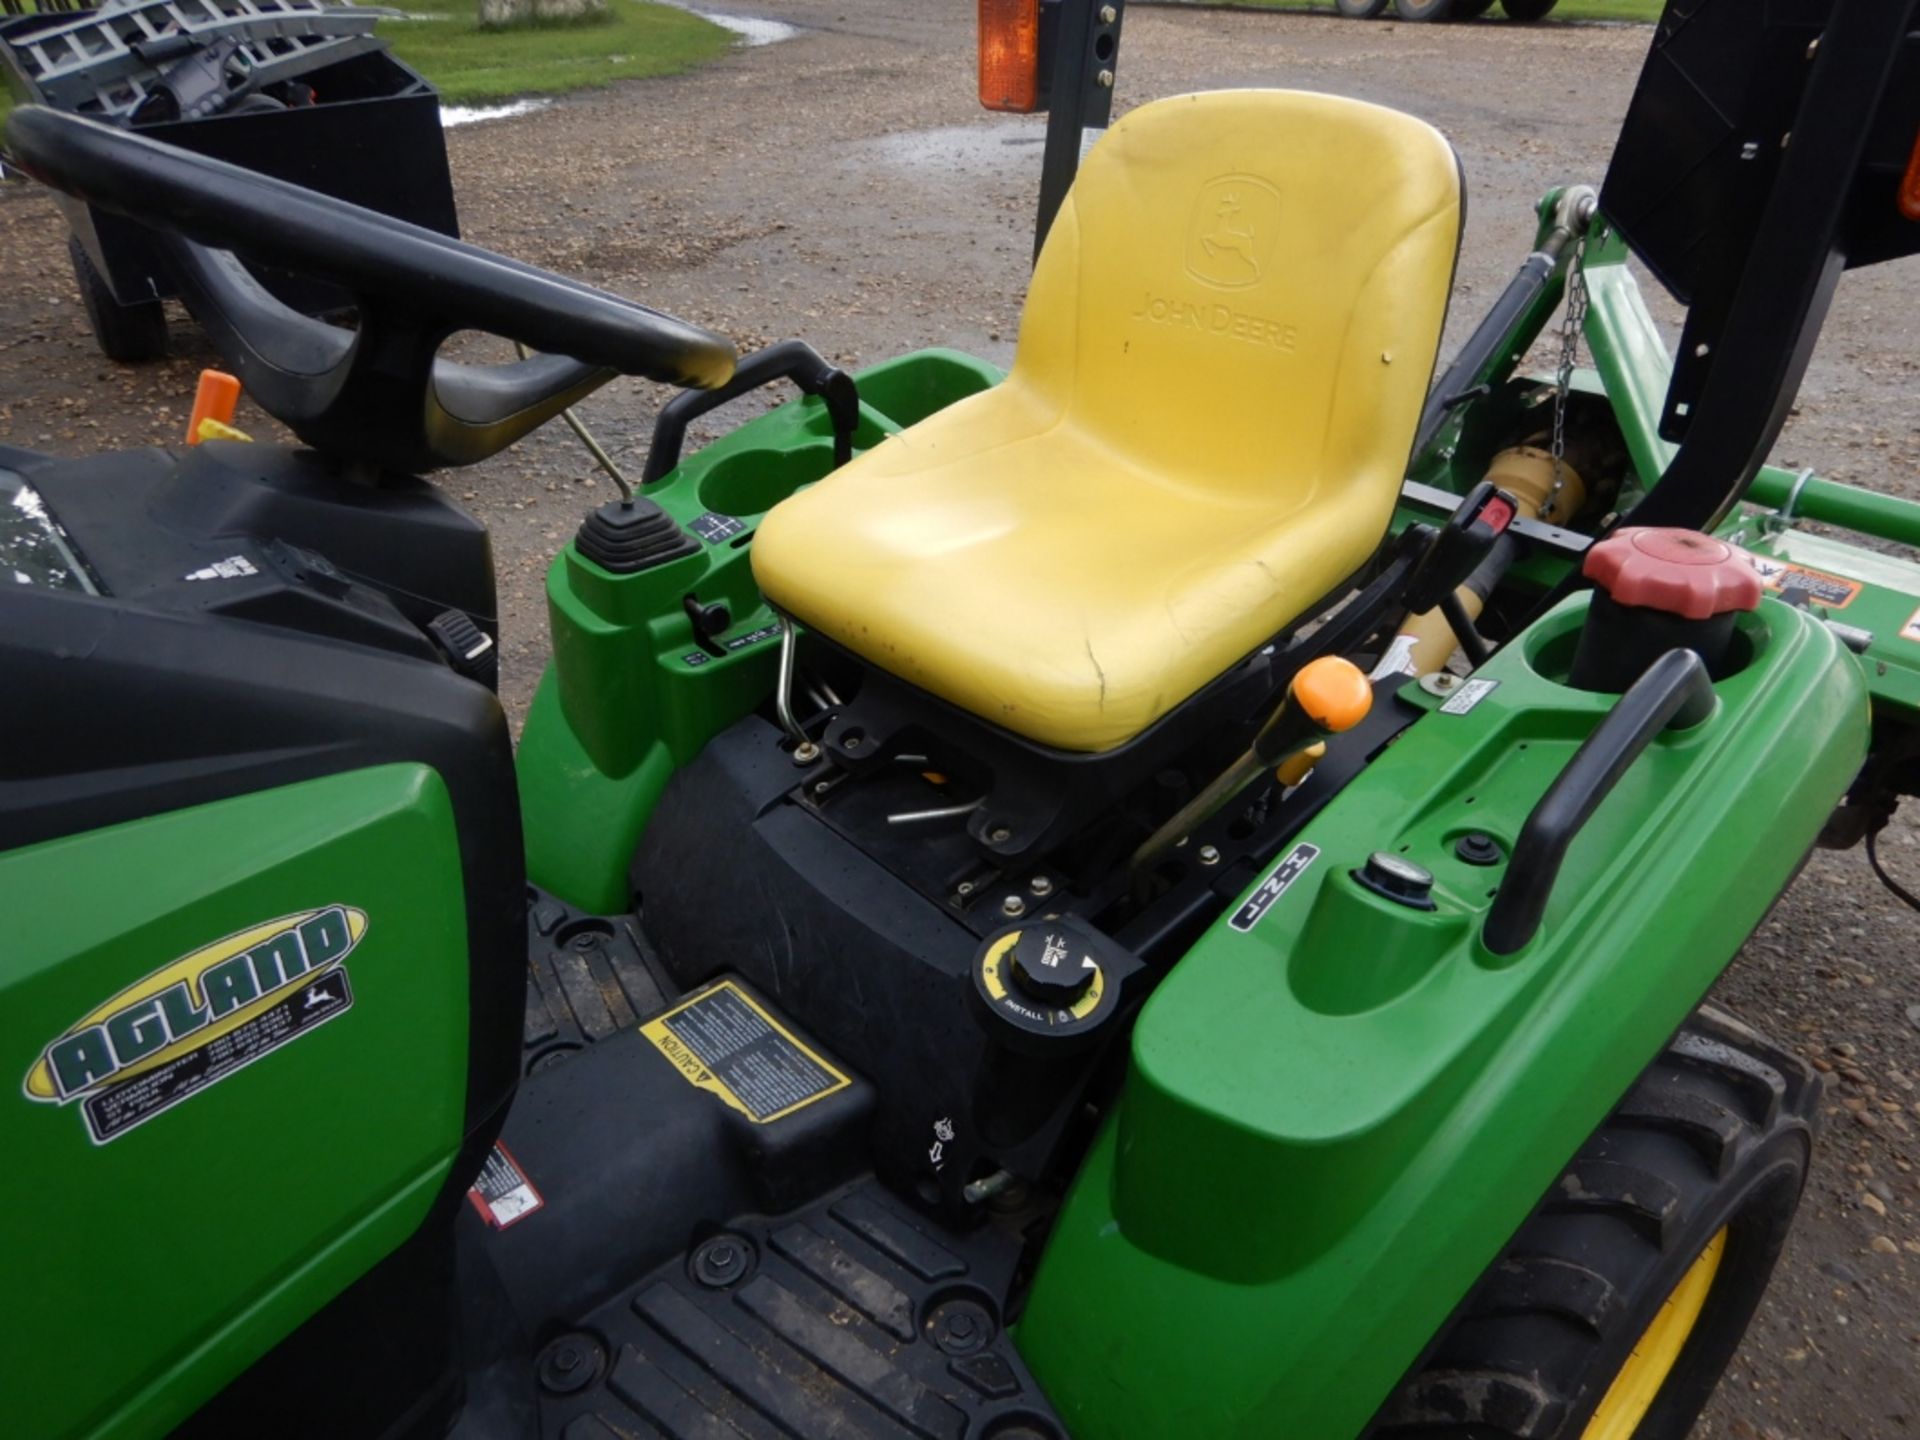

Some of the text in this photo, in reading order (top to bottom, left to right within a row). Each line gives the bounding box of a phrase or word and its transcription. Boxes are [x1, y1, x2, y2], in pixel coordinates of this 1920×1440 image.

[1131, 292, 1298, 354] JOHN DEERE
[48, 907, 352, 1103] AGLAND
[1004, 999, 1045, 1021] INSTALL
[658, 1035, 701, 1076] CAUTION
